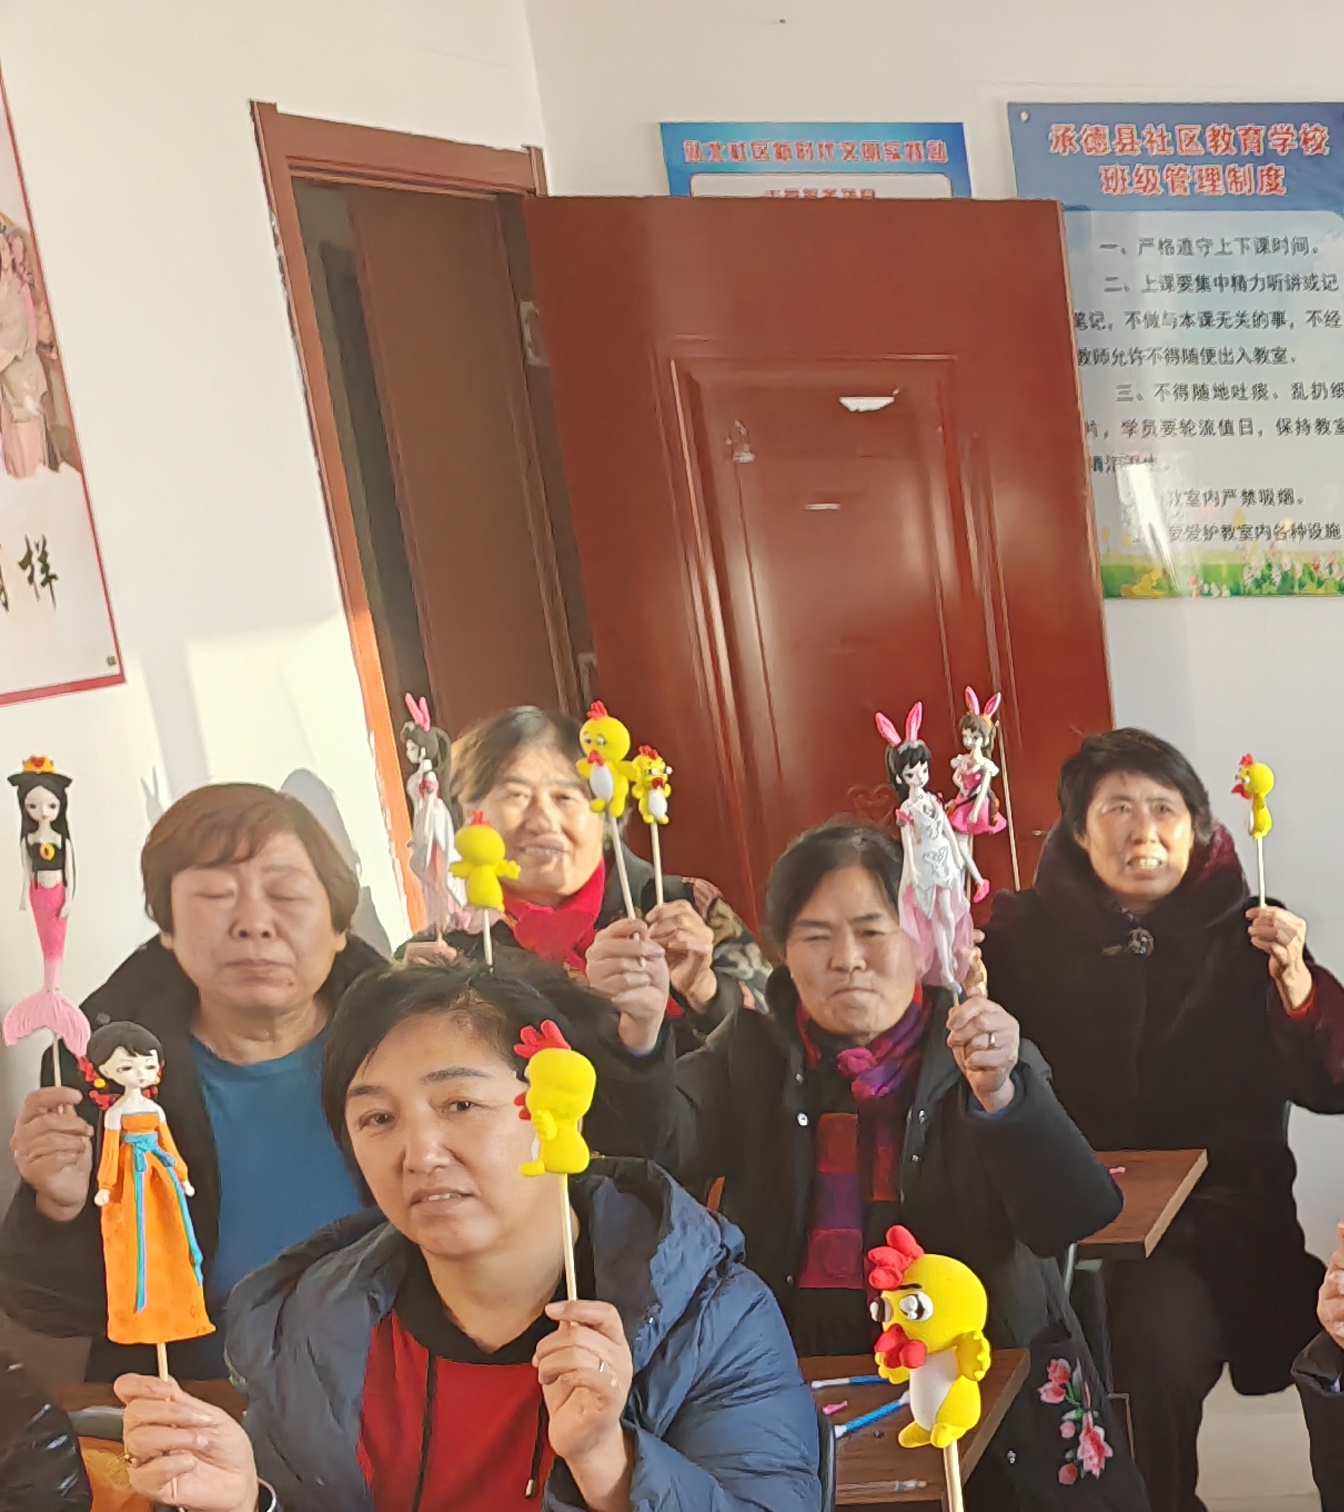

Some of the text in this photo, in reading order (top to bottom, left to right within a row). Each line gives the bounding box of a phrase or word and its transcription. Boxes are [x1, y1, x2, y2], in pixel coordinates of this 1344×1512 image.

[1049, 123, 1331, 157] 承德县社区教育学校
[1099, 164, 1287, 196] 班级管理制度
